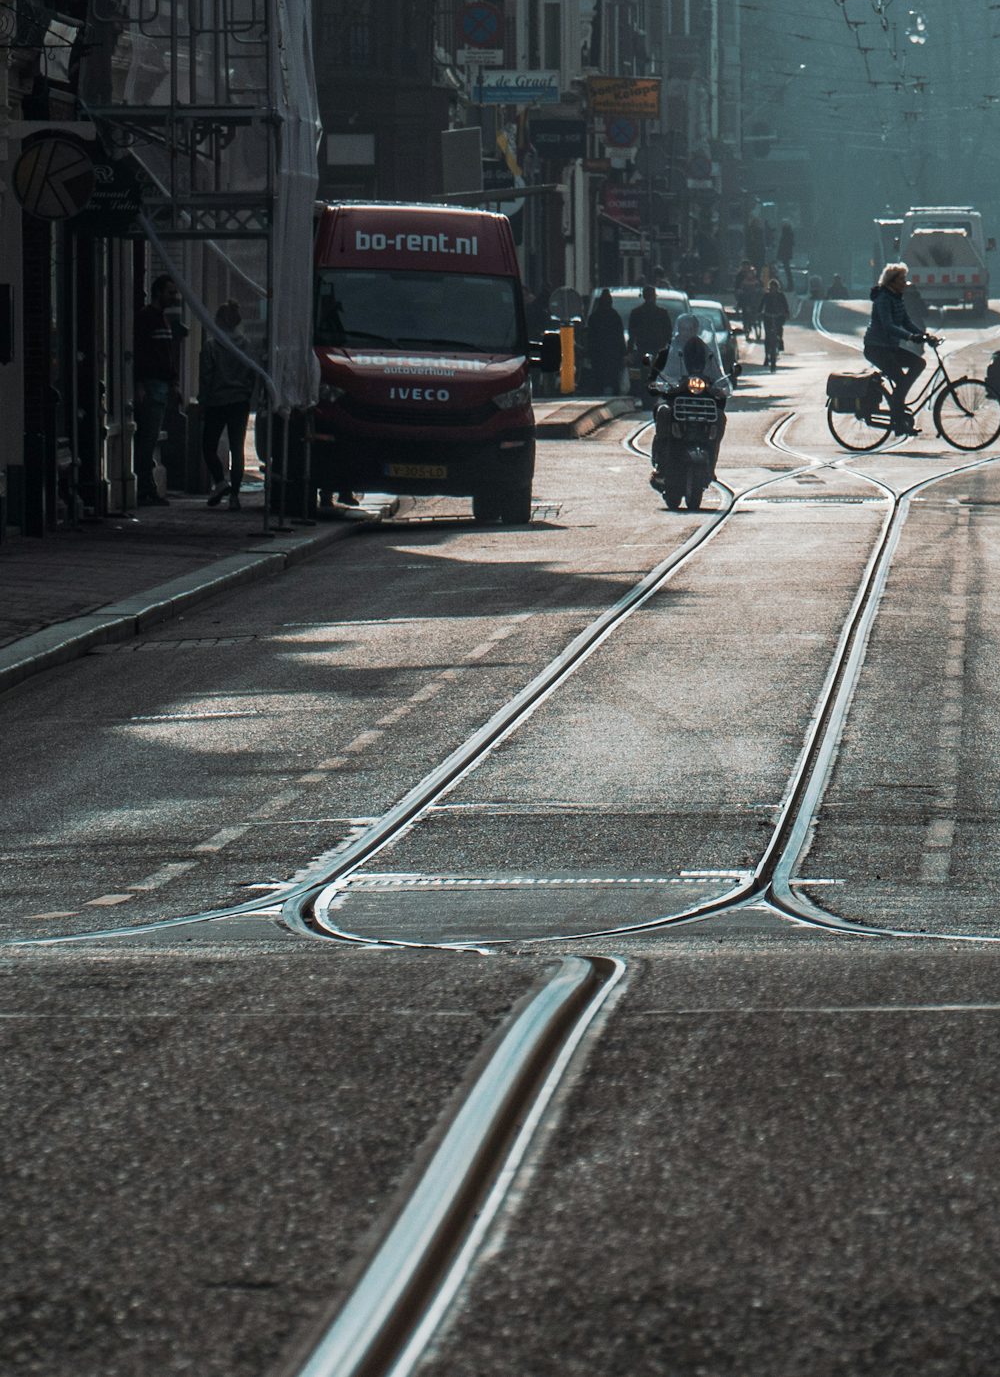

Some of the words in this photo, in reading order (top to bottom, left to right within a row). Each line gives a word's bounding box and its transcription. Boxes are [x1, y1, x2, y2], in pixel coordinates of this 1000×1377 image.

[355, 230, 478, 256] bo-rent.nl
[384, 366, 456, 377] autoverhuur
[389, 387, 450, 402] IVECO
